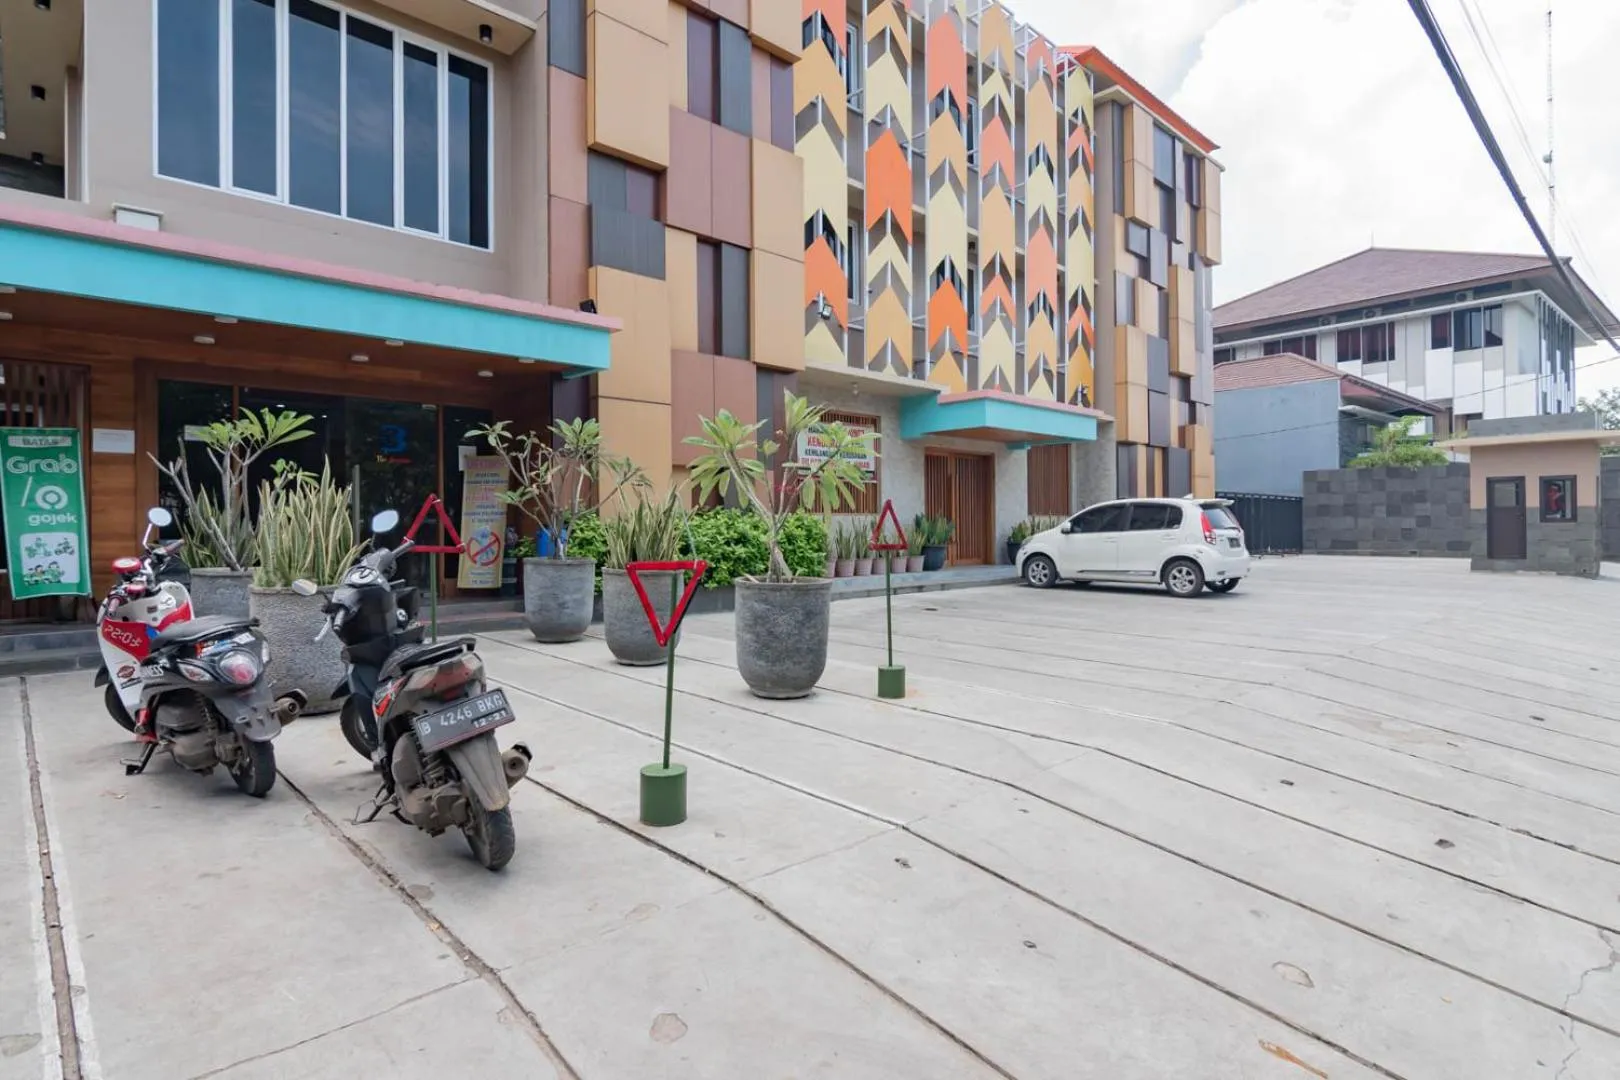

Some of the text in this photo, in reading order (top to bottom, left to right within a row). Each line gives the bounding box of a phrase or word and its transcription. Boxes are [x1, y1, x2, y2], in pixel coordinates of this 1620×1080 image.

[7, 453, 78, 474] Grab
[28, 512, 78, 527] gojek
[420, 694, 503, 736] B 4246 BKG
